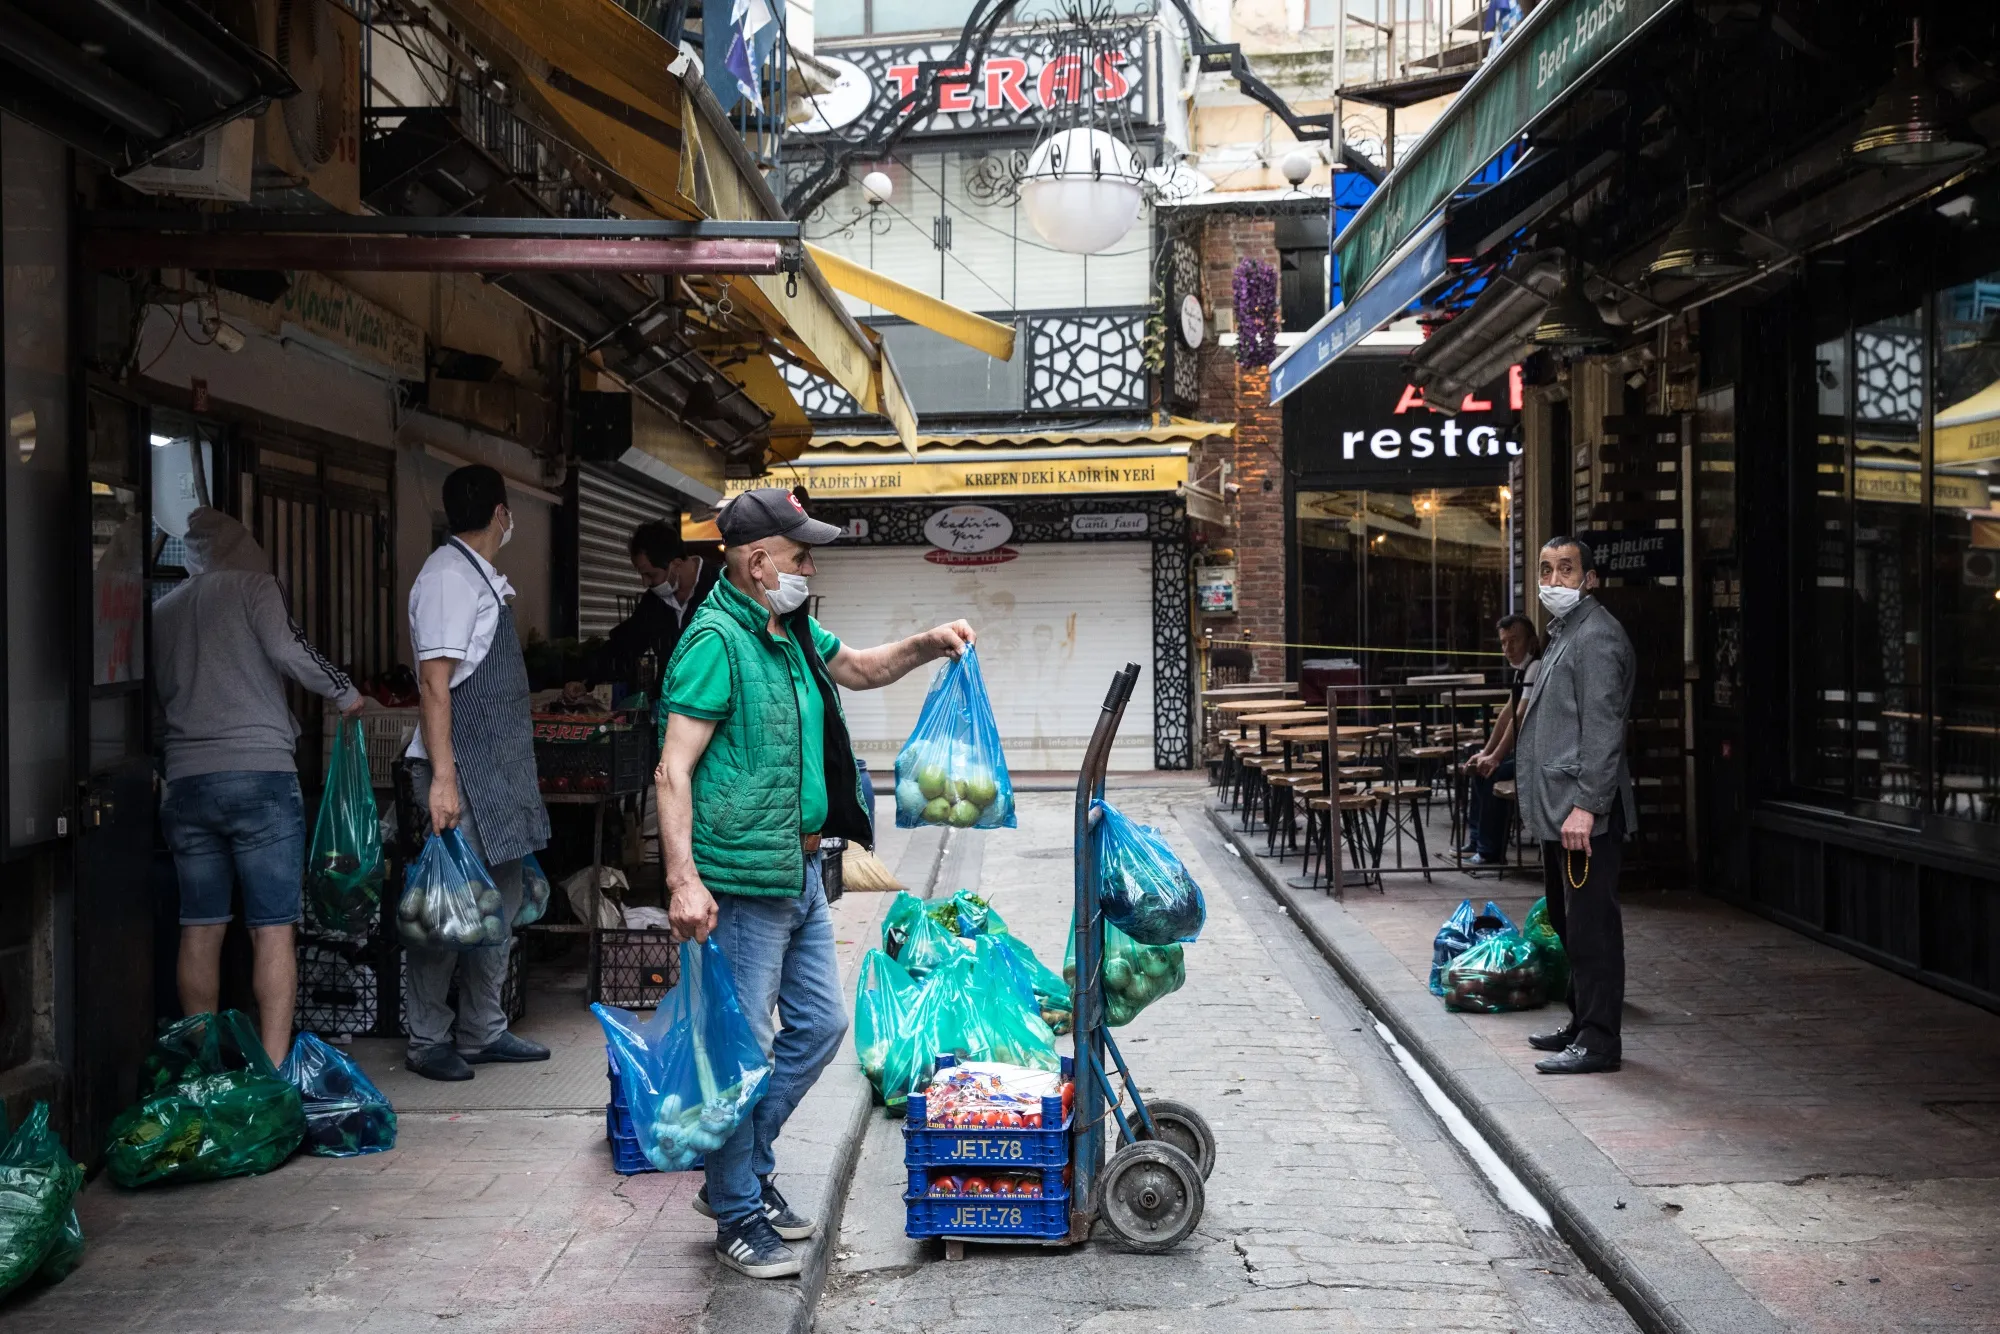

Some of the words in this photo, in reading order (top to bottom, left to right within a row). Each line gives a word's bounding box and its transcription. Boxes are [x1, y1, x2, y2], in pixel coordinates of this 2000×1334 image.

[1536, 35, 1571, 90] Beer
[885, 50, 1129, 116] TERAS
[809, 473, 867, 489] KADİR'İN
[871, 472, 902, 488] YERİ
[965, 467, 1054, 487] KREPEN'DEKİ
[1058, 466, 1119, 483] KADİR'İN
[1123, 465, 1155, 482] YERİ
[1610, 553, 1647, 571] GÜZEL
[533, 723, 596, 743] EŞREF
[950, 1139, 1022, 1158] JET-78
[950, 1207, 1022, 1226] JET-78
